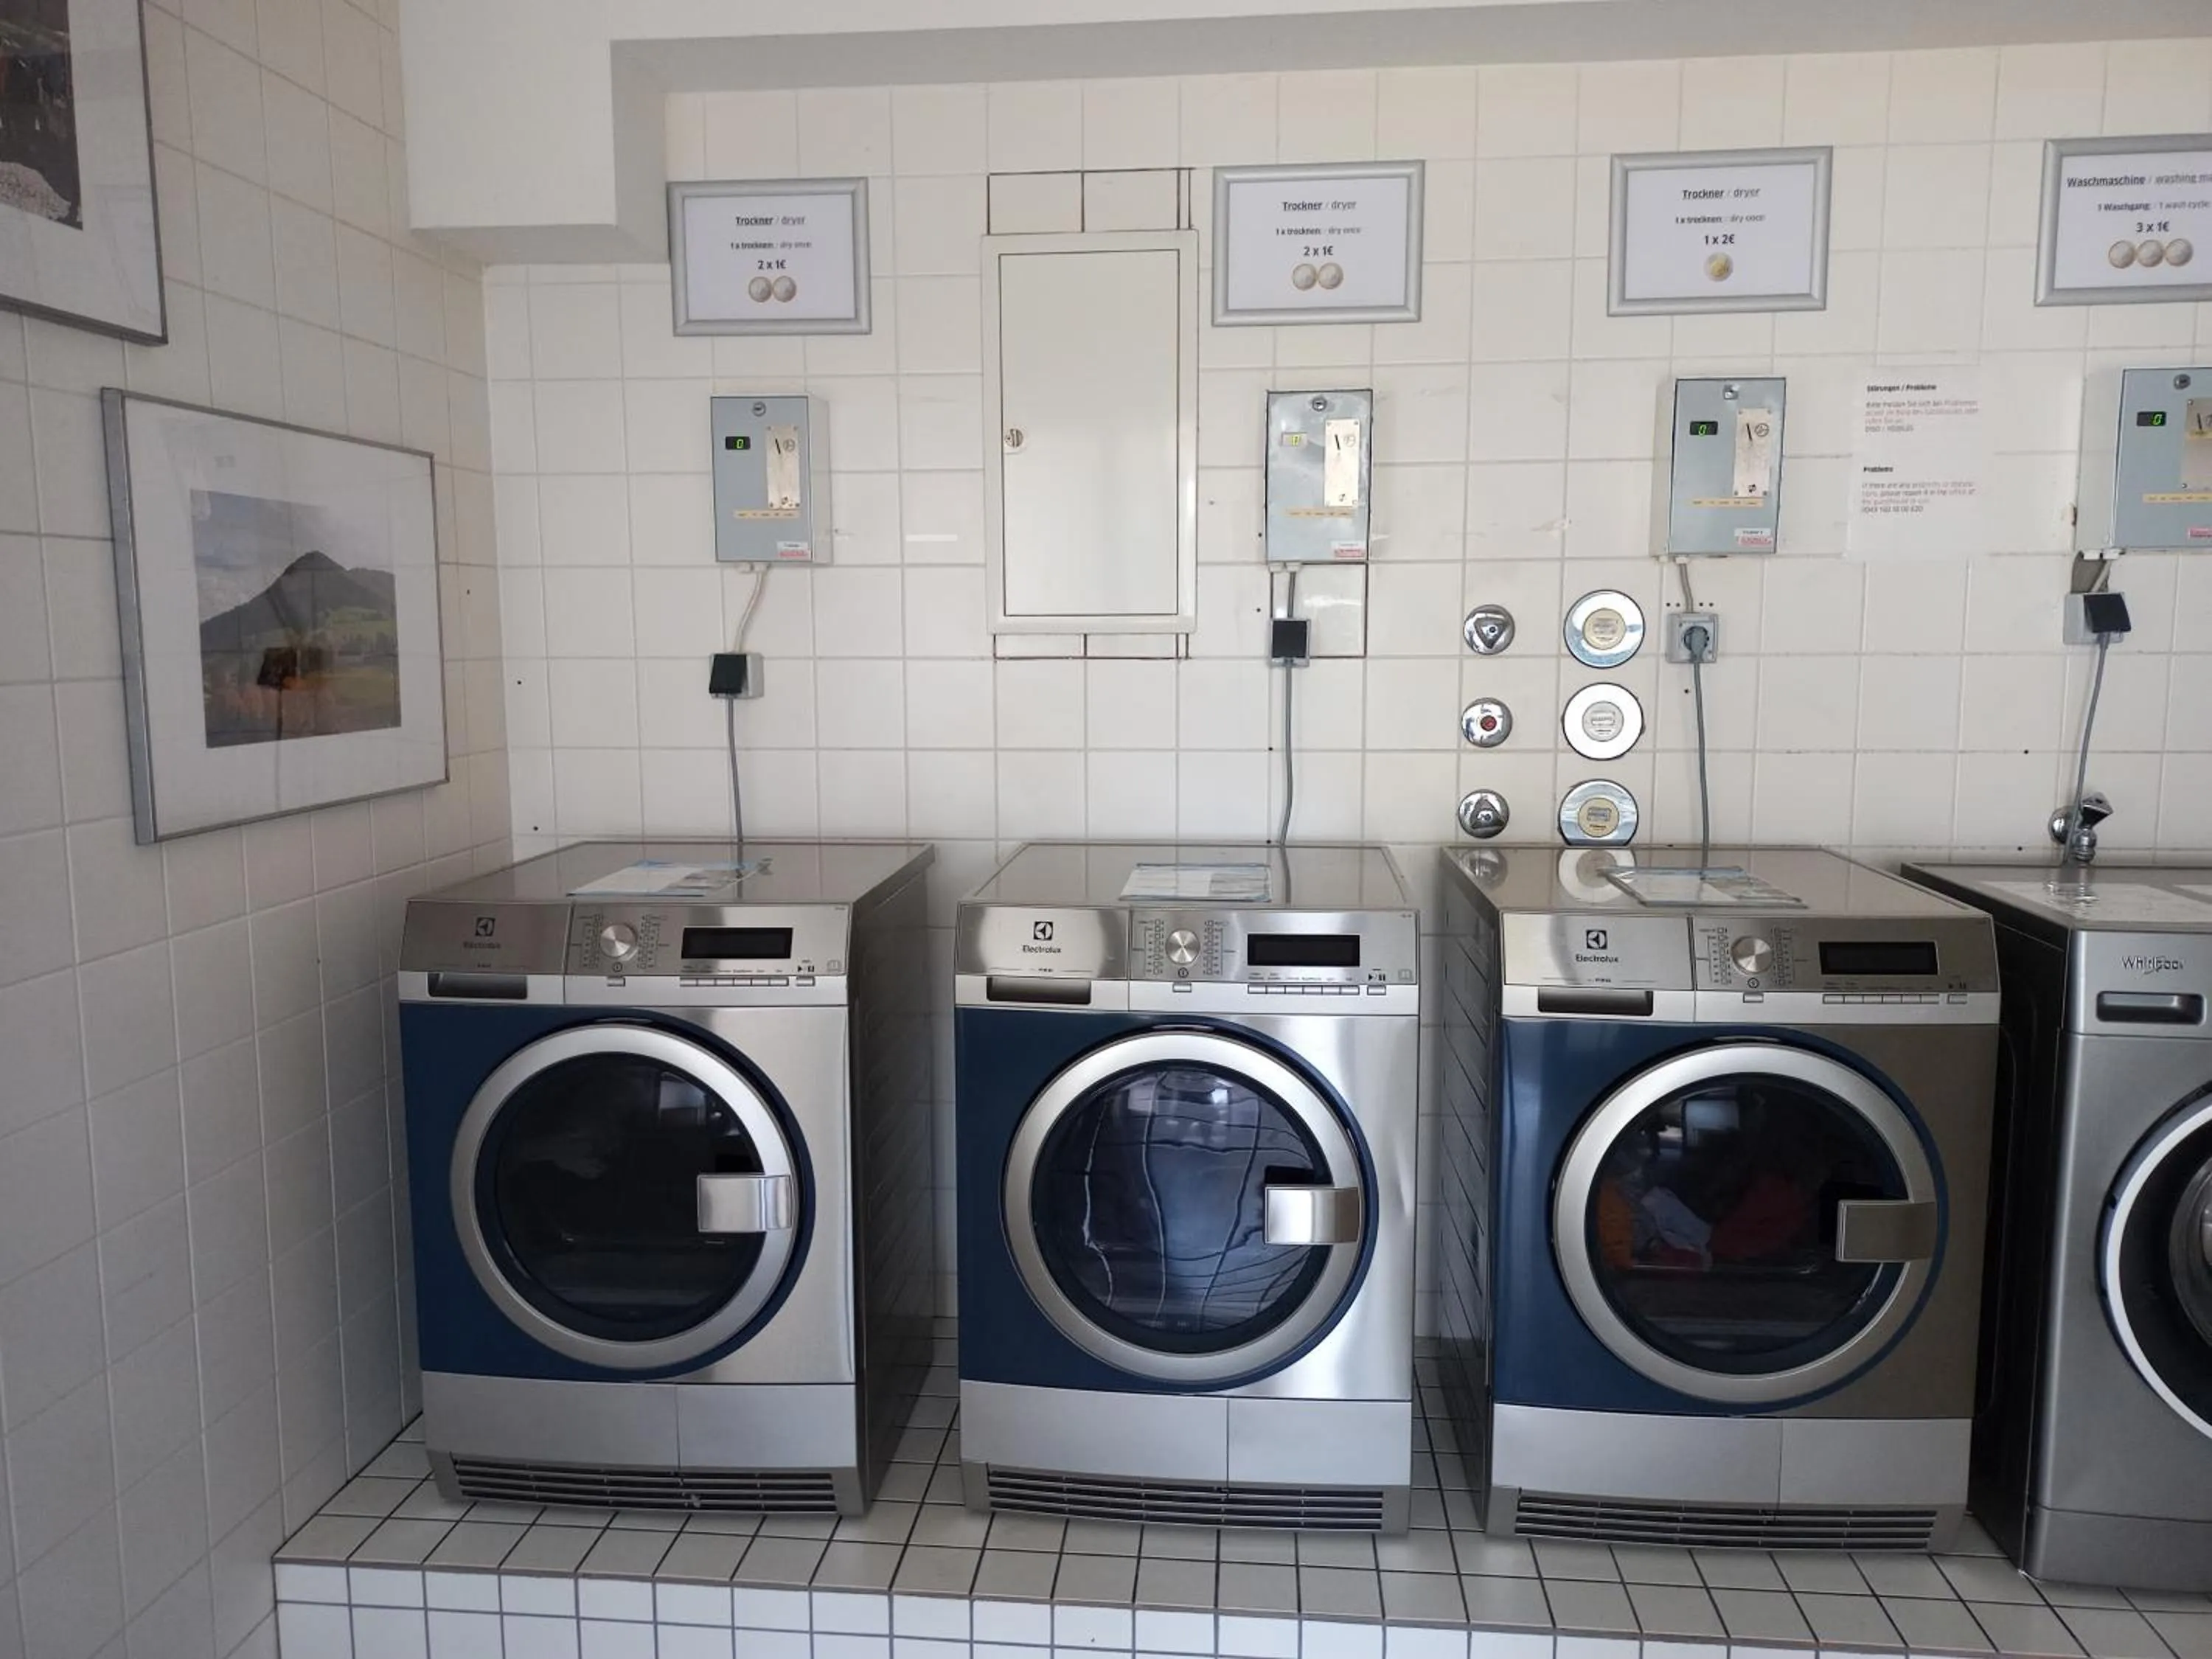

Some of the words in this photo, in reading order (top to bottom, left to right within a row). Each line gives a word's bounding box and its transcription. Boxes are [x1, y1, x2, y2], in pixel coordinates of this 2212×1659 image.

[2067, 175, 2146, 187] Waschmaschine
[1683, 189, 1724, 200] Trockner
[1733, 188, 1761, 199] dryer
[1282, 201, 1322, 212] Trockner
[1331, 200, 1357, 211] dryer
[736, 216, 773, 226] Trockner
[2135, 222, 2143, 232] 3
[2146, 223, 2153, 232] x
[2157, 221, 2169, 232] 1€
[1705, 235, 1709, 245] 1
[1722, 234, 1735, 245] 2€
[1304, 246, 1310, 256] 2
[1313, 248, 1319, 256] x
[1323, 246, 1333, 257] 1€
[757, 260, 764, 270] 2
[767, 261, 773, 269] x
[775, 259, 787, 269] 1€
[2152, 414, 2163, 425] 0
[1698, 424, 1707, 436] 0
[737, 439, 744, 449] 0
[1022, 945, 1062, 953] Electrolux
[1575, 953, 1618, 963] Electrolux
[2121, 955, 2185, 973] Whirlpool
